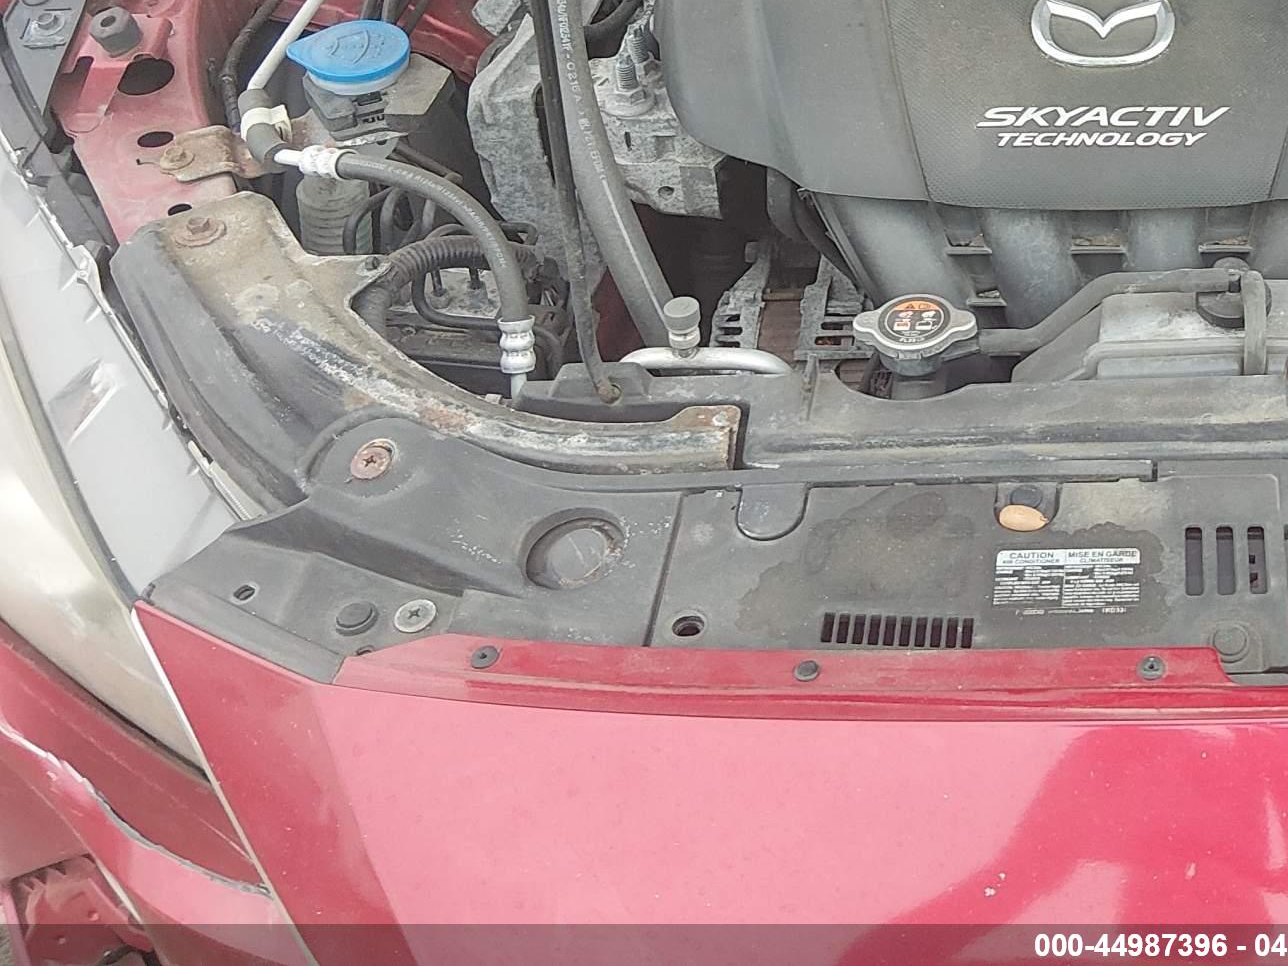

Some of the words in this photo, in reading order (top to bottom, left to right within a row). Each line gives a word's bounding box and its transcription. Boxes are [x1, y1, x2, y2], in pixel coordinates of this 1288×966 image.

[976, 106, 1231, 128] SKYACTIV
[997, 132, 1208, 148] TECHNOLOGY
[1009, 551, 1054, 559] CAUTION
[1092, 550, 1104, 558] EN
[1105, 550, 1137, 558] GARDE
